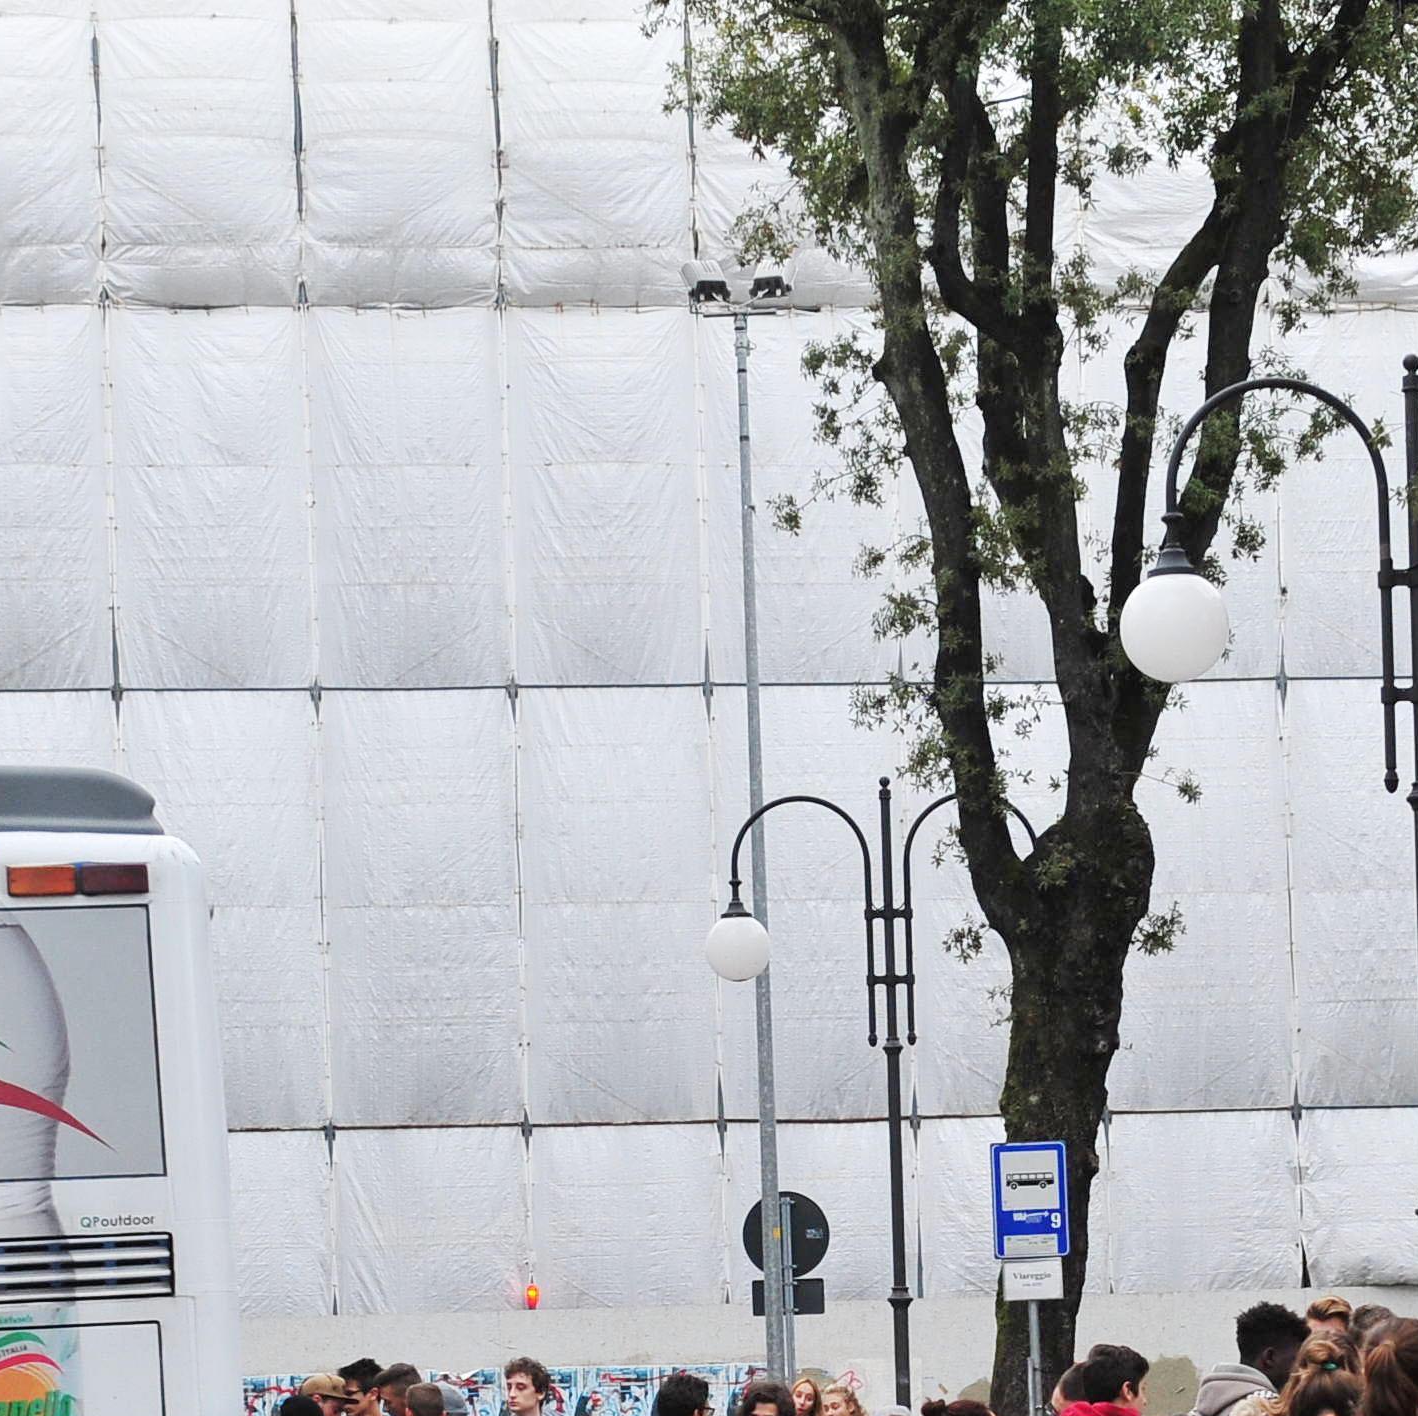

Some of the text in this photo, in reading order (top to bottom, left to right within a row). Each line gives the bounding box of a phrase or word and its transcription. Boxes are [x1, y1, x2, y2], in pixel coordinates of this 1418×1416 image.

[80, 1215, 156, 1229] QPoutdoor
[1050, 1212, 1062, 1228] 9
[1012, 1272, 1052, 1280] Viareggio
